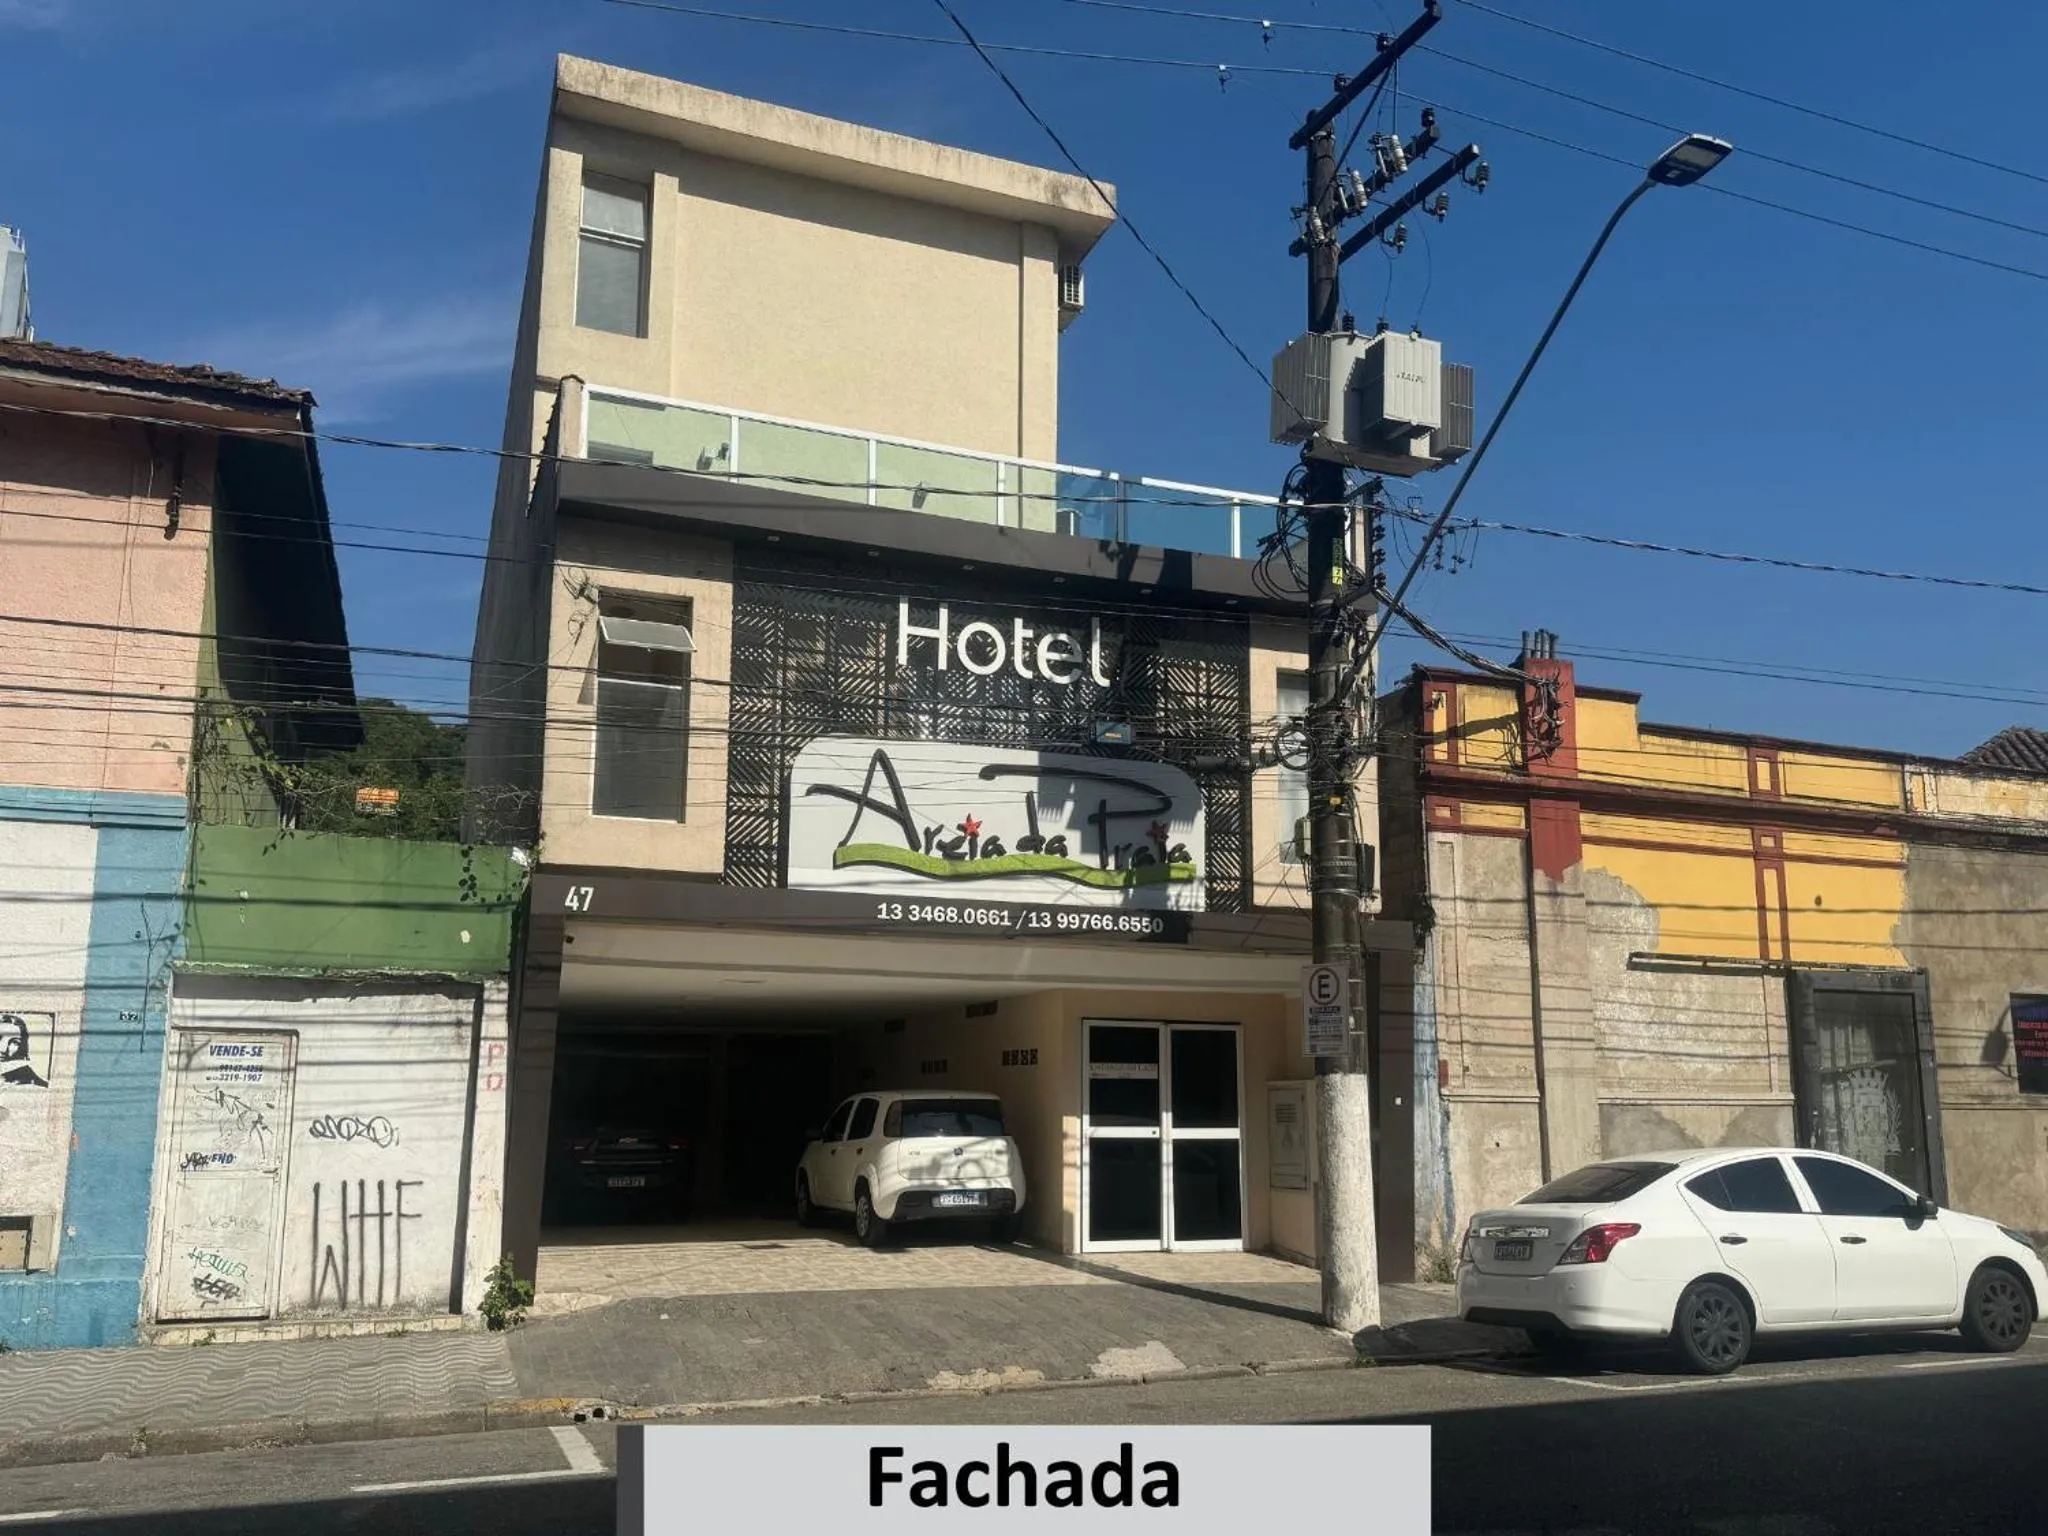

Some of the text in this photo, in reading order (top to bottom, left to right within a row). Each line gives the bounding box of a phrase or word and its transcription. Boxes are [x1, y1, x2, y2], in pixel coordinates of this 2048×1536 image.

[898, 596, 1111, 688] Hotel
[805, 748, 1193, 870] Areia da Praia
[564, 885, 595, 912] 47
[877, 903, 902, 921] 13
[908, 905, 1012, 927] 3468.0661
[1056, 912, 1164, 934] 99766.6550
[1318, 974, 1331, 999] E
[209, 1045, 264, 1057] VENDE-SE
